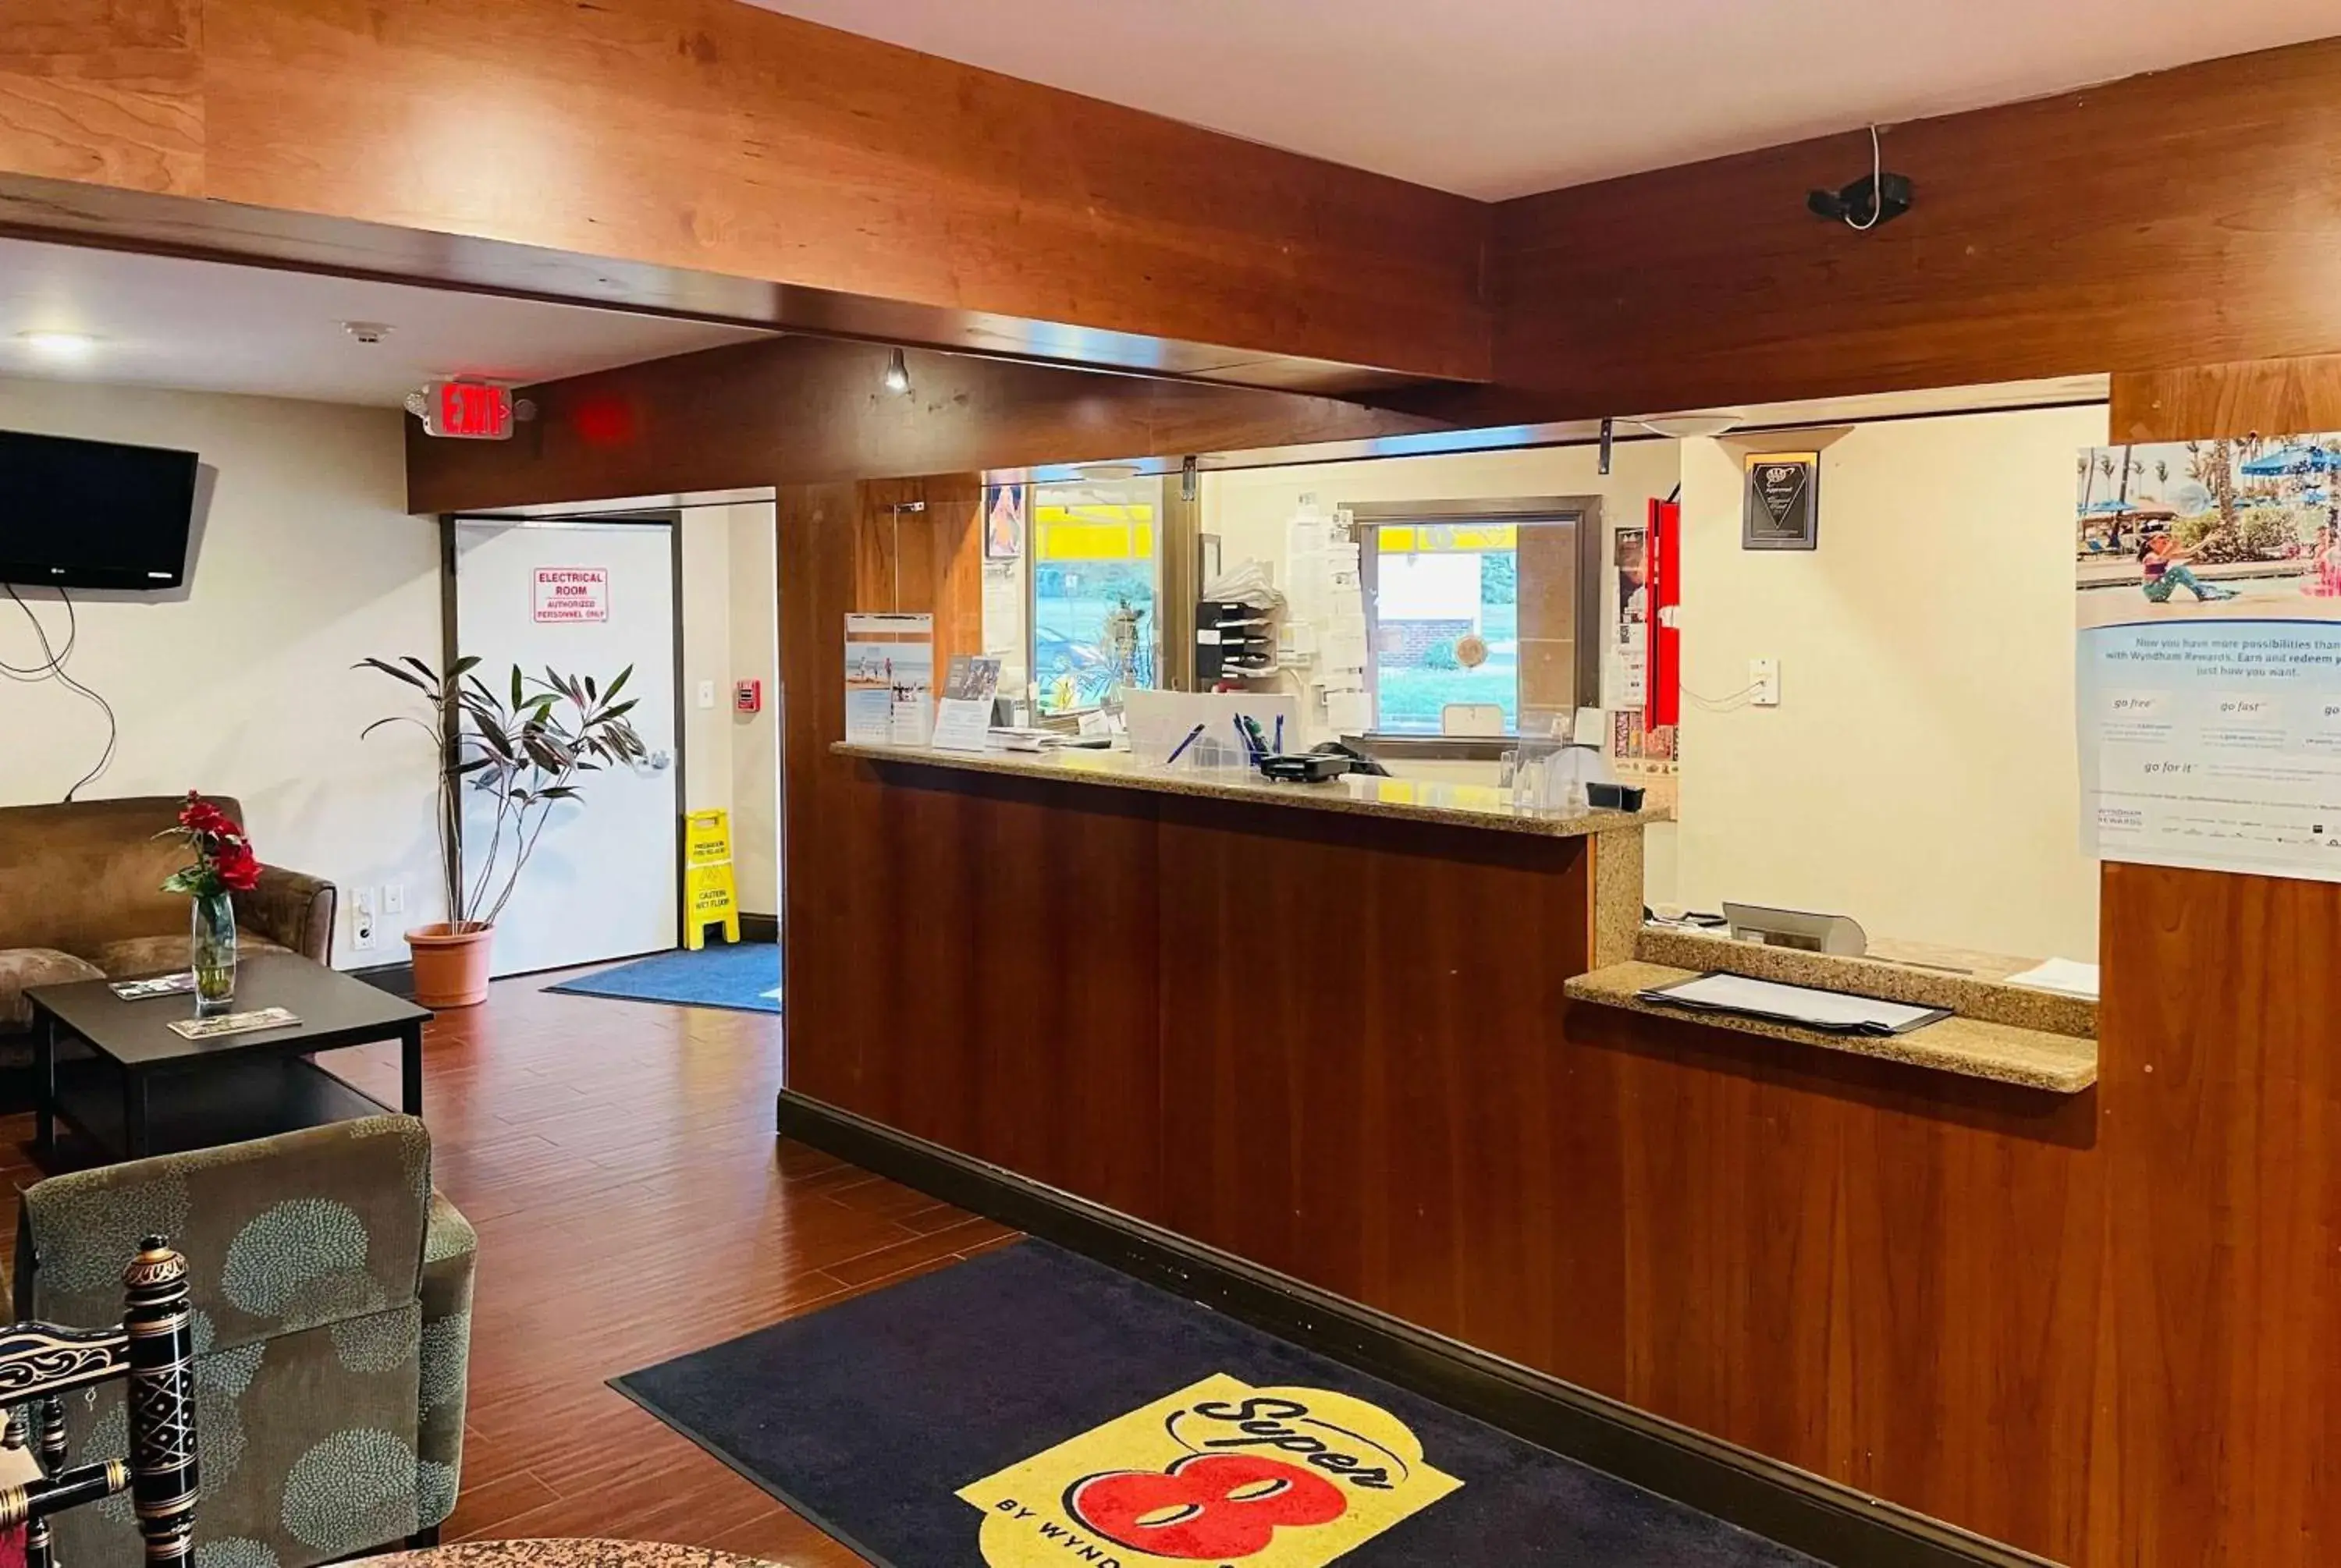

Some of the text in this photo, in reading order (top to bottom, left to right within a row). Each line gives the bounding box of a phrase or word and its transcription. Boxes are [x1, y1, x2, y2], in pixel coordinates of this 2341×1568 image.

[441, 383, 500, 435] EXIT
[539, 573, 602, 583] ELECTRICAL
[556, 586, 587, 595] ROOM
[547, 600, 595, 608] AUTHORIZED
[585, 610, 604, 619] ONLY
[2160, 640, 2179, 648] you
[2183, 638, 2208, 648] have
[2242, 638, 2310, 650] possibilities
[2105, 651, 2128, 660] with
[2130, 651, 2181, 662] Wyndham
[2237, 652, 2262, 662] Earn
[2265, 654, 2286, 663] and
[2288, 655, 2332, 663] redeem
[2197, 666, 2216, 676] just
[2220, 665, 2243, 676] how
[2246, 669, 2265, 678] you
[2113, 700, 2128, 709] go
[2220, 702, 2236, 711] go
[2325, 706, 2340, 717] go
[2144, 761, 2192, 774] go for it
[1193, 1398, 1394, 1489] Super
[995, 1499, 1036, 1519] BY
